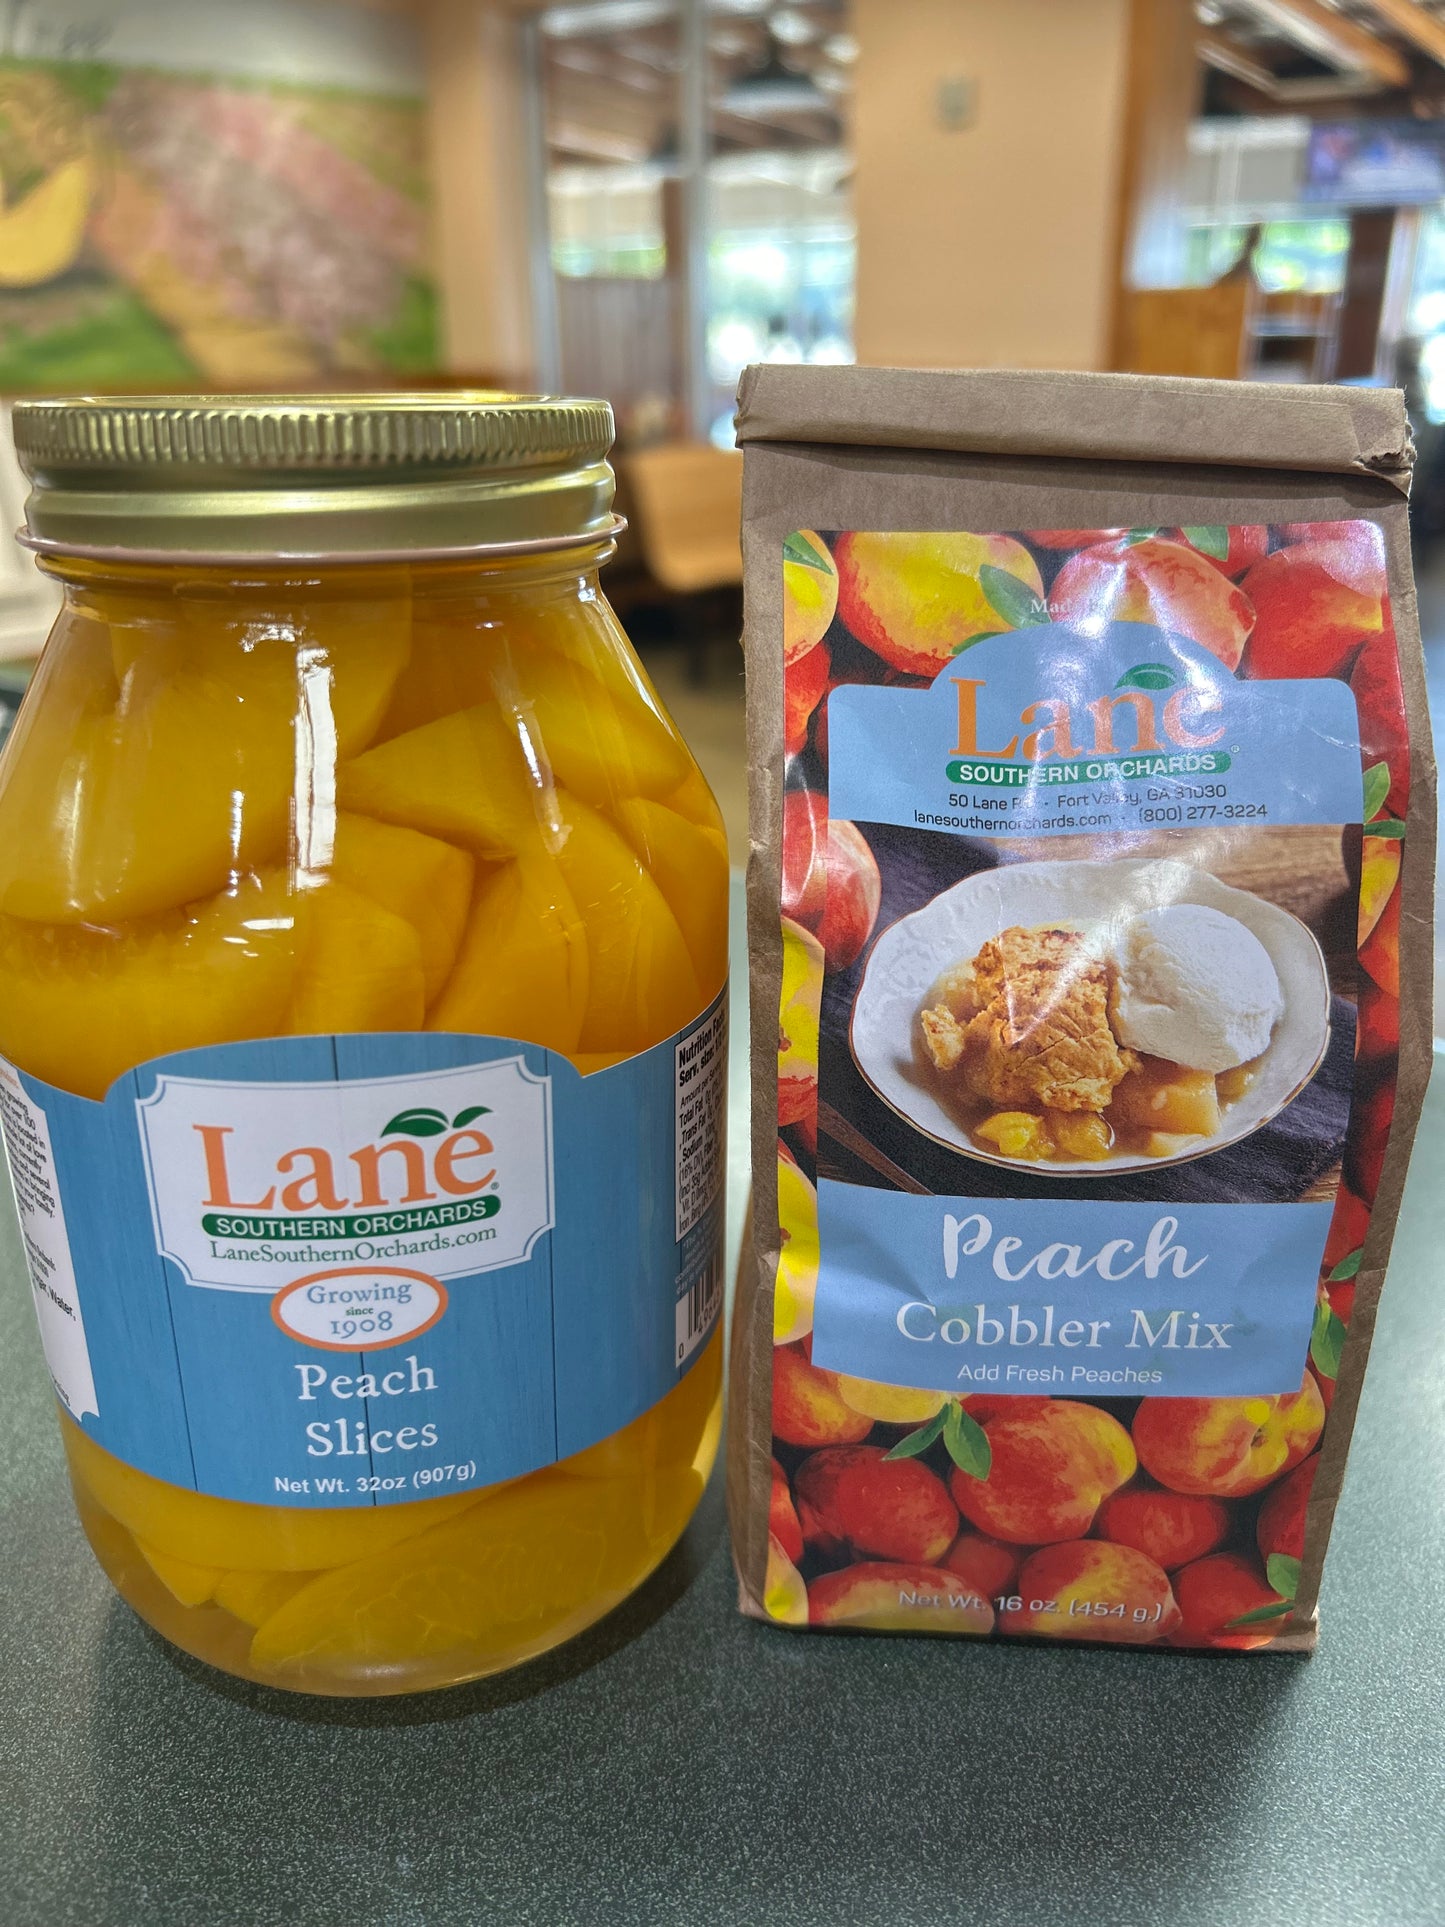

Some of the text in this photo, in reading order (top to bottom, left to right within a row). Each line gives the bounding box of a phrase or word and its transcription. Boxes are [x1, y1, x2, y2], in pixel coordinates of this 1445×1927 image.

[948, 677, 1226, 760] Lane
[959, 754, 1217, 785] SOUTHERN ORCHARDS
[949, 794, 968, 808] 50
[973, 795, 1008, 810] Lane
[1057, 794, 1090, 808] Fort
[1147, 787, 1171, 801] GA
[1138, 806, 1183, 823] (800)
[1187, 804, 1268, 820] 277-3224
[192, 1124, 497, 1212] Lane
[216, 1200, 486, 1238] SOUTHERN ORCHARDS
[210, 1228, 497, 1263] LaneSouthernOrchards.com
[943, 1214, 1210, 1282] Peach
[307, 1283, 412, 1304] Growing
[330, 1311, 393, 1339] 1908
[345, 1306, 374, 1316] since
[896, 1301, 1234, 1349] Cobbler Mix
[295, 1355, 438, 1400] Peach
[957, 1364, 1163, 1384] Add Fresh Peaches
[306, 1418, 438, 1456] Slices
[274, 1460, 477, 1493] Net Wt. 32oz (907g)
[899, 1590, 1162, 1623] Net Wt. 16 oz. (454 g.)
